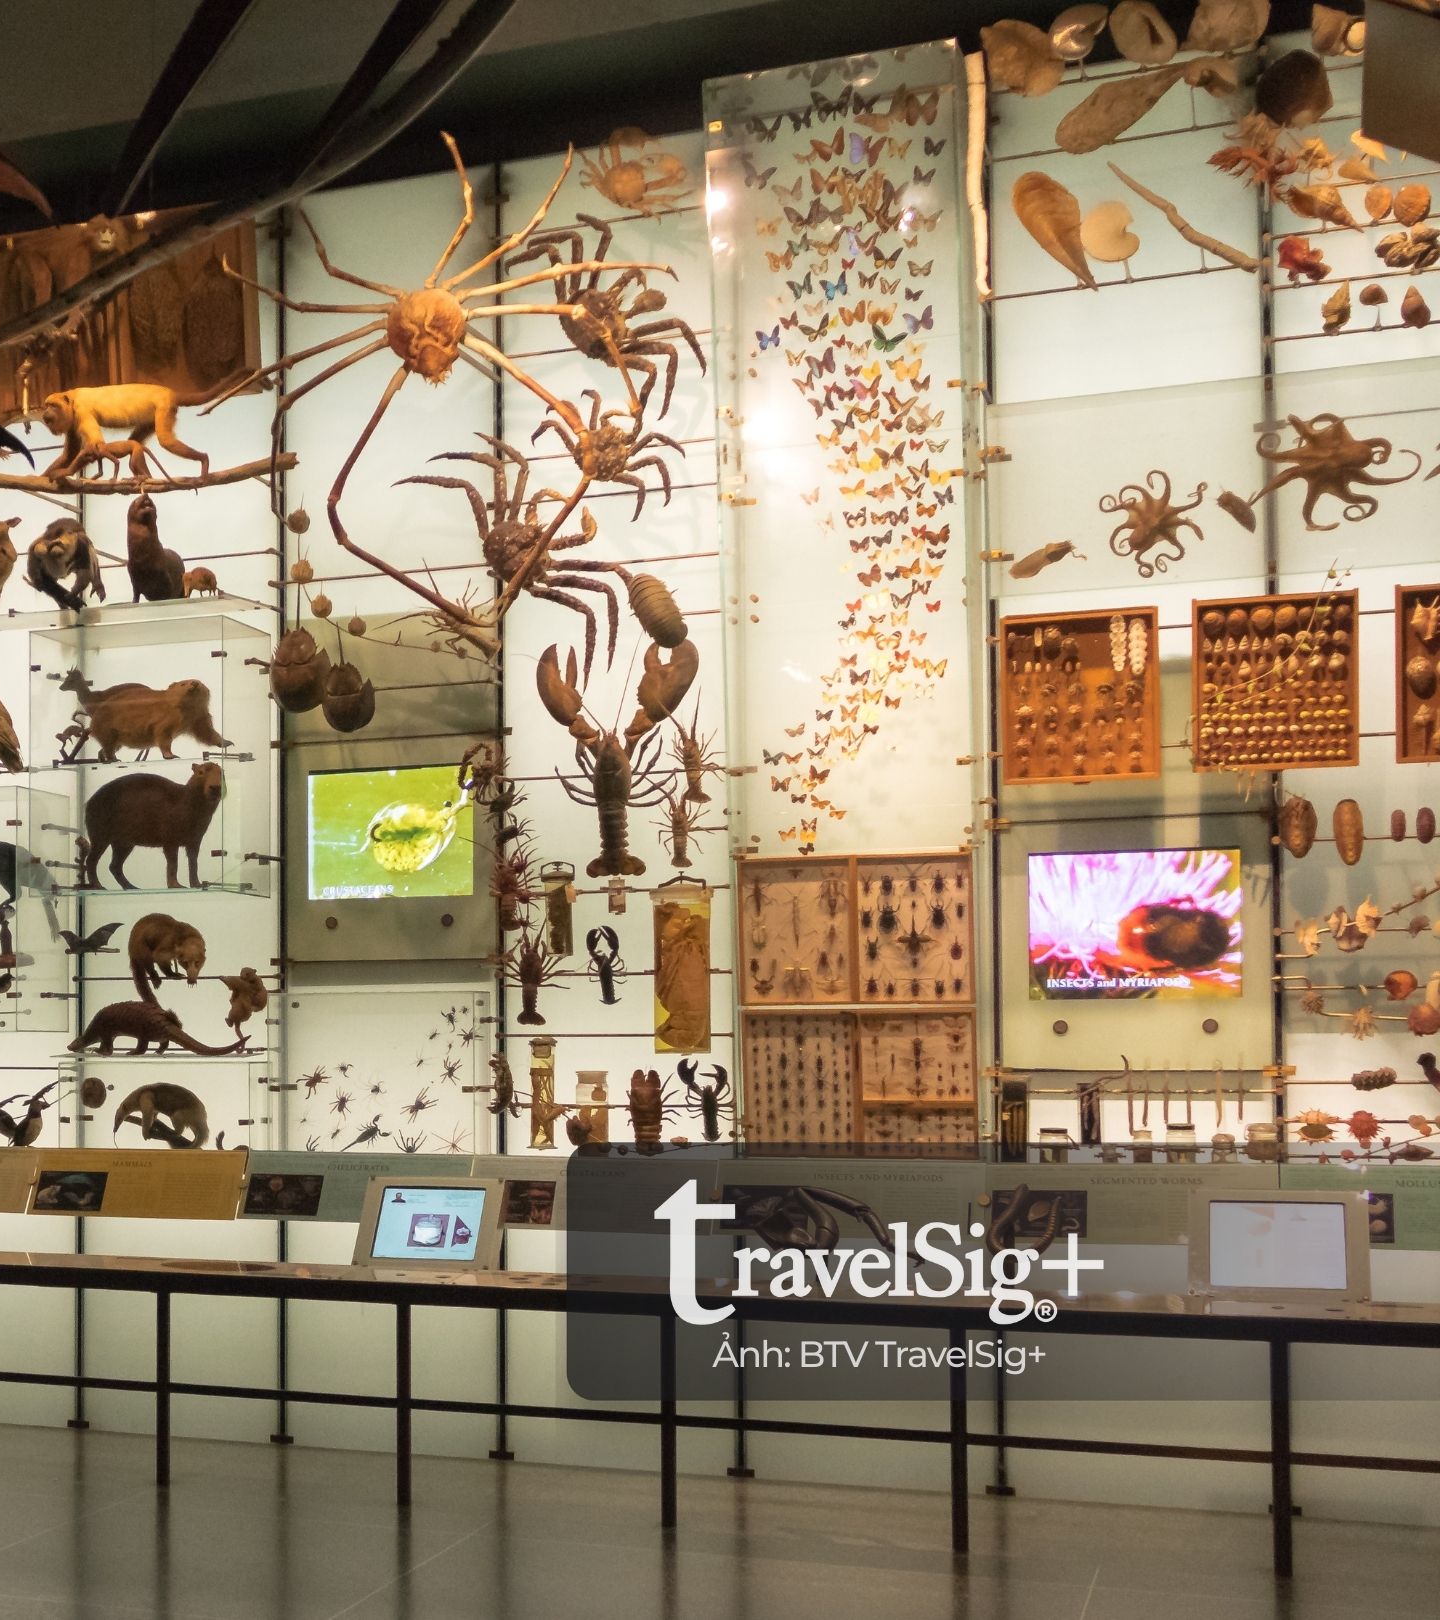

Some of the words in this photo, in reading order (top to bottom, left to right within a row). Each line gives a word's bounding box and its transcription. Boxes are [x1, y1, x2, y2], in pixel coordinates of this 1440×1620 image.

[323, 885, 393, 897] CRUSTACEANS
[1047, 978, 1094, 988] INSECTS
[1097, 978, 1117, 987] and
[814, 1173, 855, 1181] INSECTS
[859, 1173, 881, 1182] AND
[883, 1173, 944, 1183] MYRIAPODS
[1089, 1176, 1158, 1185] SEGMENTED
[1160, 1177, 1204, 1185] WORMS
